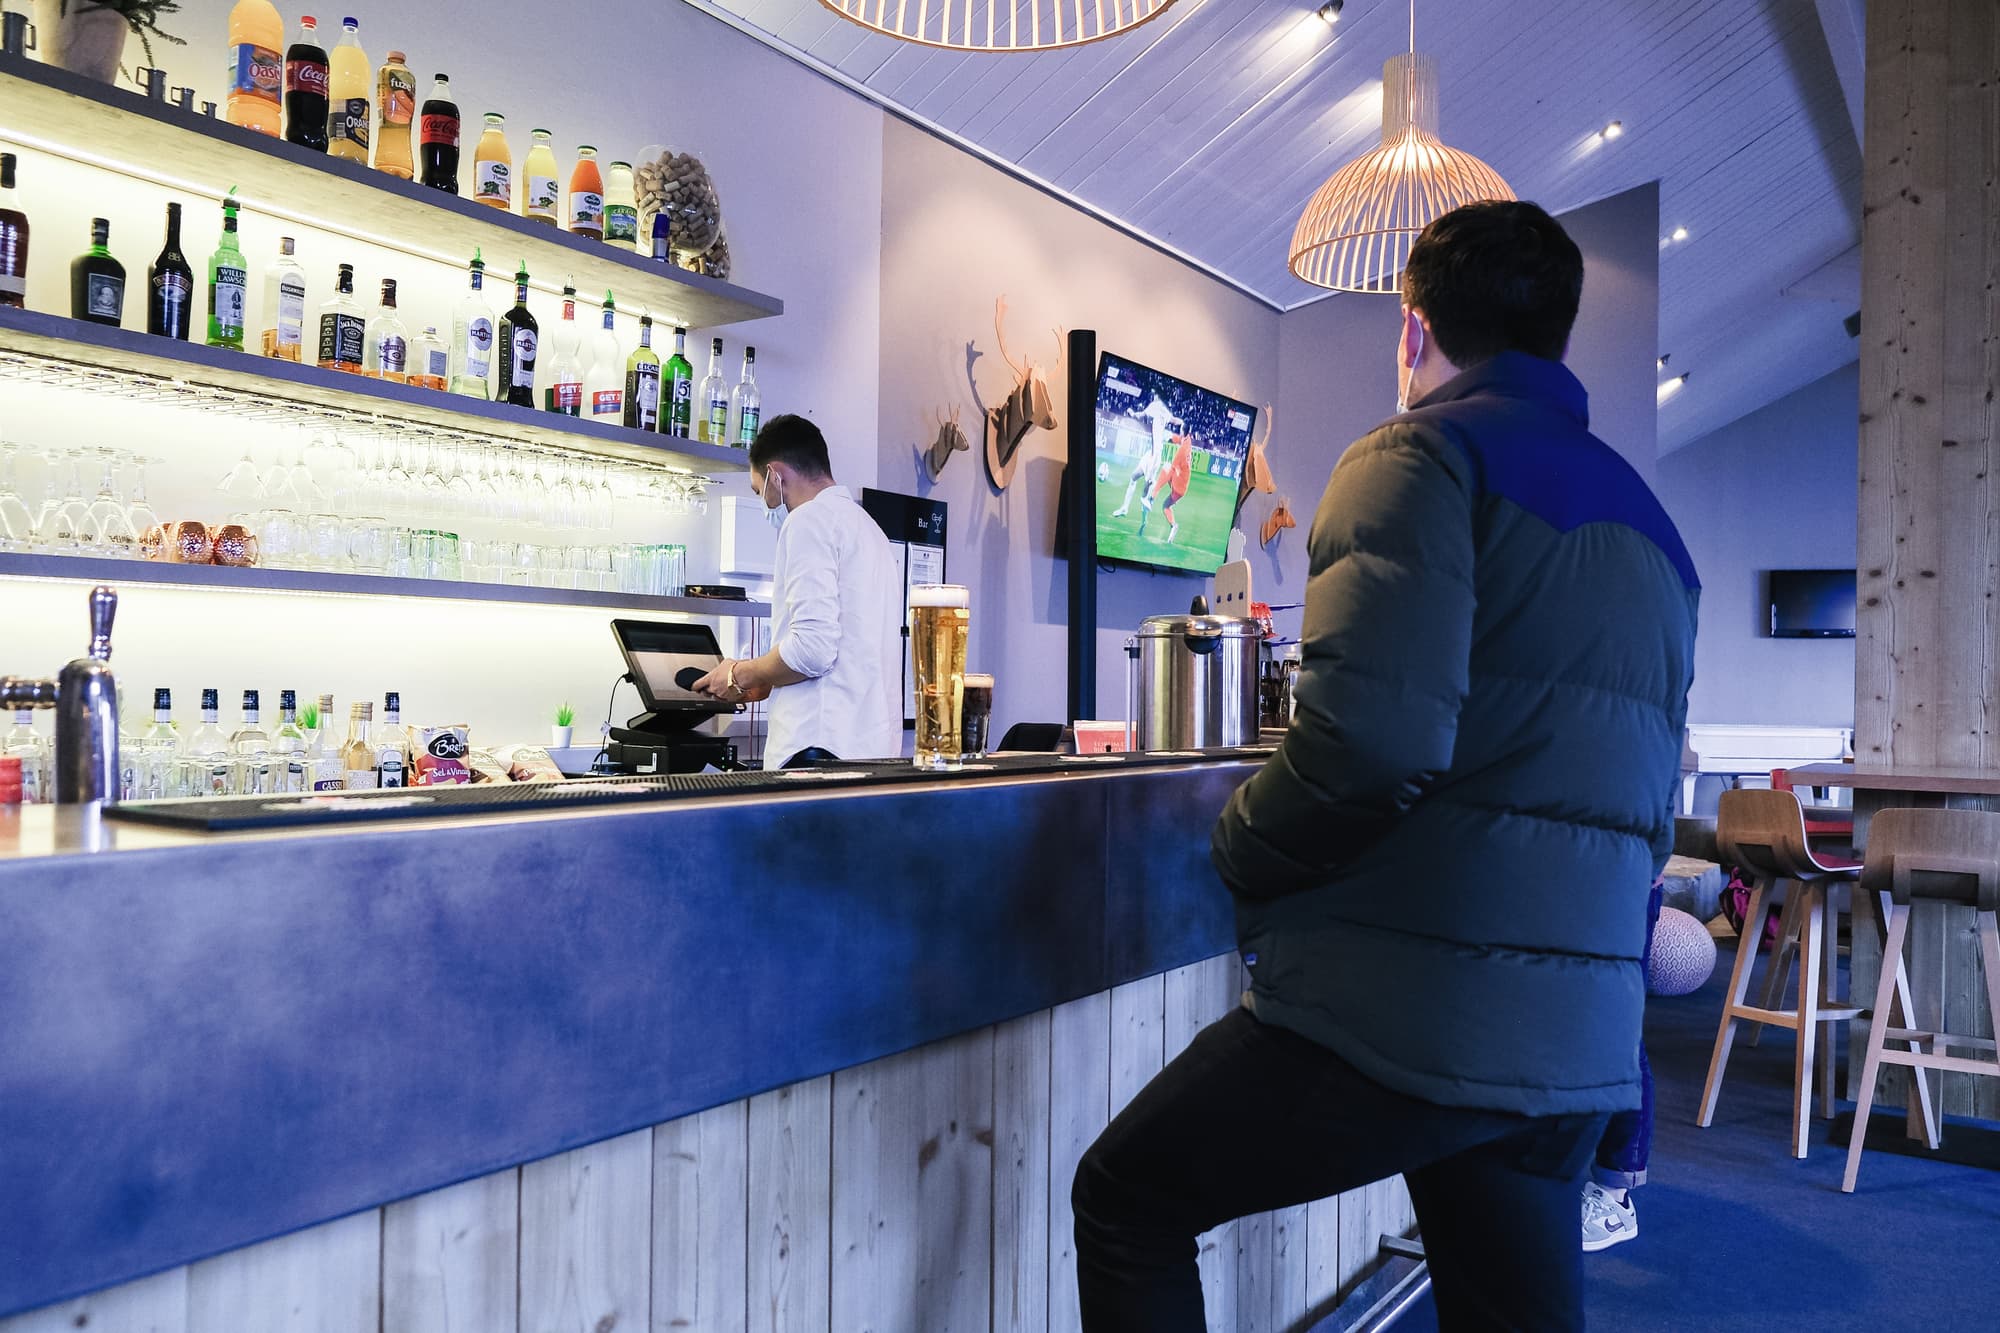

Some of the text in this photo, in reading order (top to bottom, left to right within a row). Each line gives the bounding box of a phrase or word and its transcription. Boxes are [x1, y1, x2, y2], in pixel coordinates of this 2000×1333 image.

[220, 268, 246, 278] WILLIA
[218, 275, 246, 285] LAWSO
[559, 385, 577, 394] GET
[678, 381, 691, 397] 51
[599, 394, 615, 402] GET
[918, 518, 929, 529] Bar
